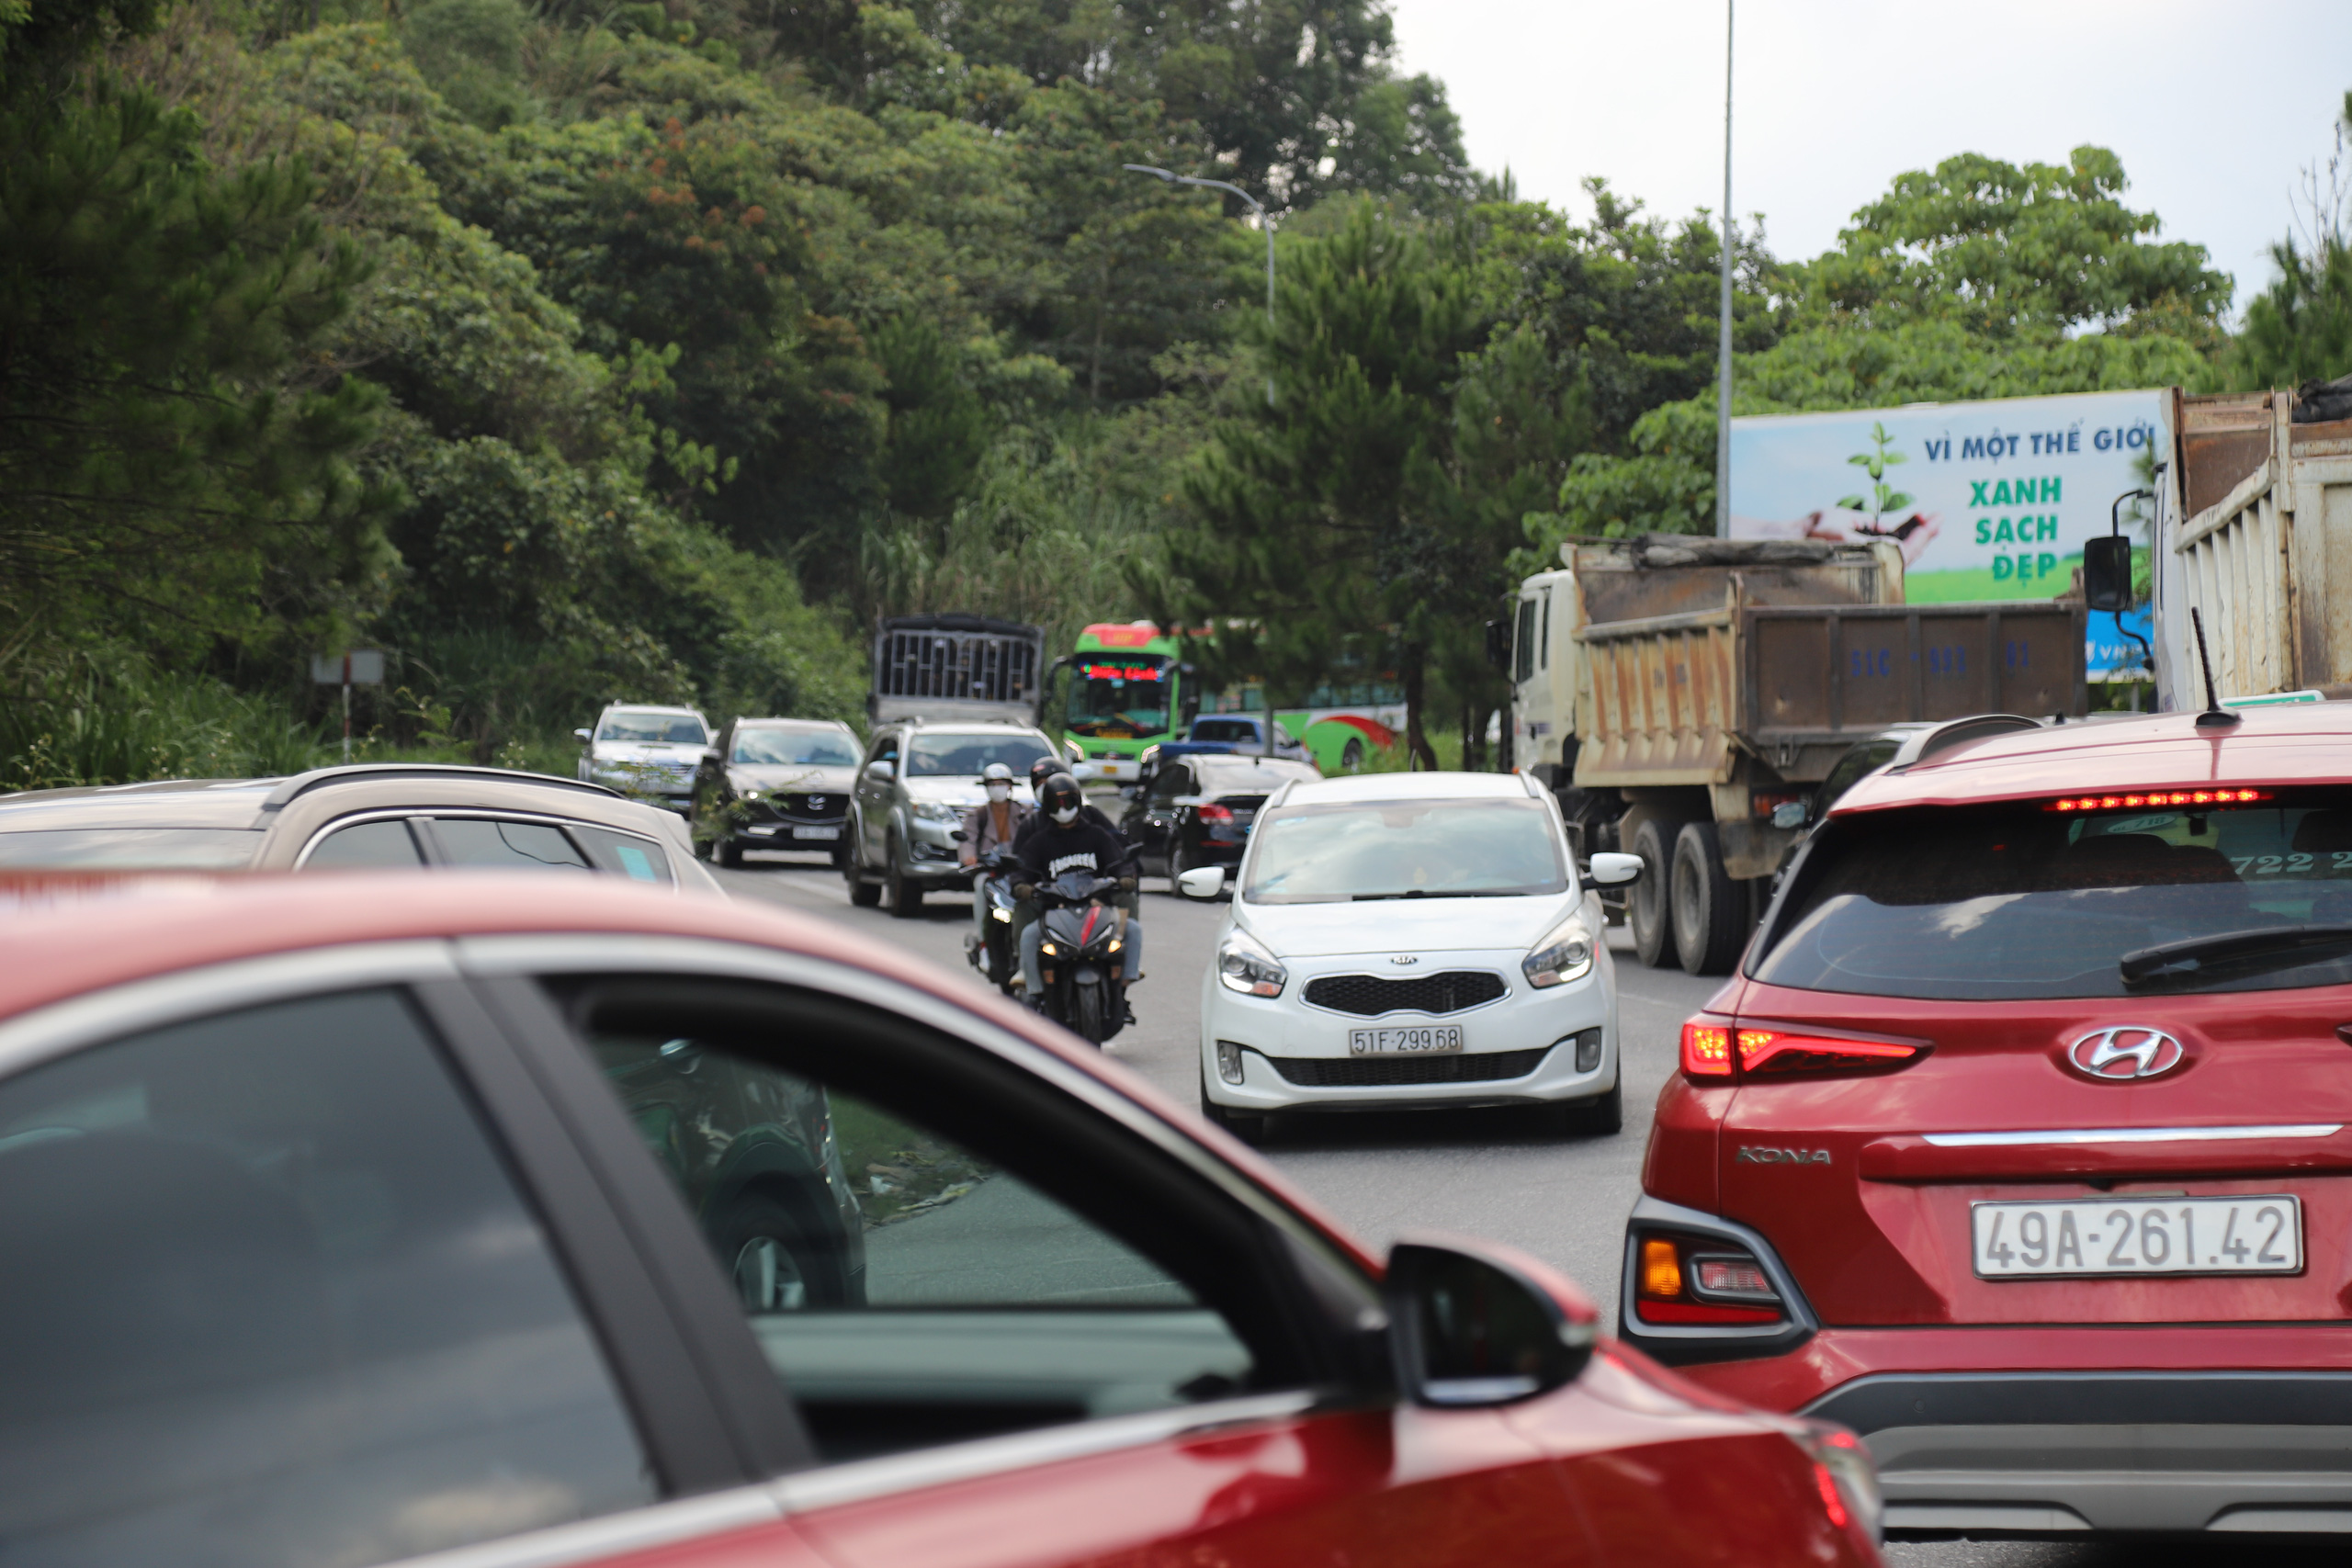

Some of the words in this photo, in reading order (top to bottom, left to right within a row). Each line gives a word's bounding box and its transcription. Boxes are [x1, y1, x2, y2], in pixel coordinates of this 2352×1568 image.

[1925, 429, 1951, 460] VÌ
[1962, 426, 2019, 466] MỘT
[2030, 417, 2085, 455] THẾ
[1969, 476, 2062, 508] XANH
[1975, 514, 2058, 551] SẠCH
[1992, 553, 2057, 588] ĐẸP
[1354, 1029, 1458, 1053] 51F-299.68
[1736, 1145, 1831, 1165] KONA
[1986, 1205, 2287, 1269] 49A-261.42
